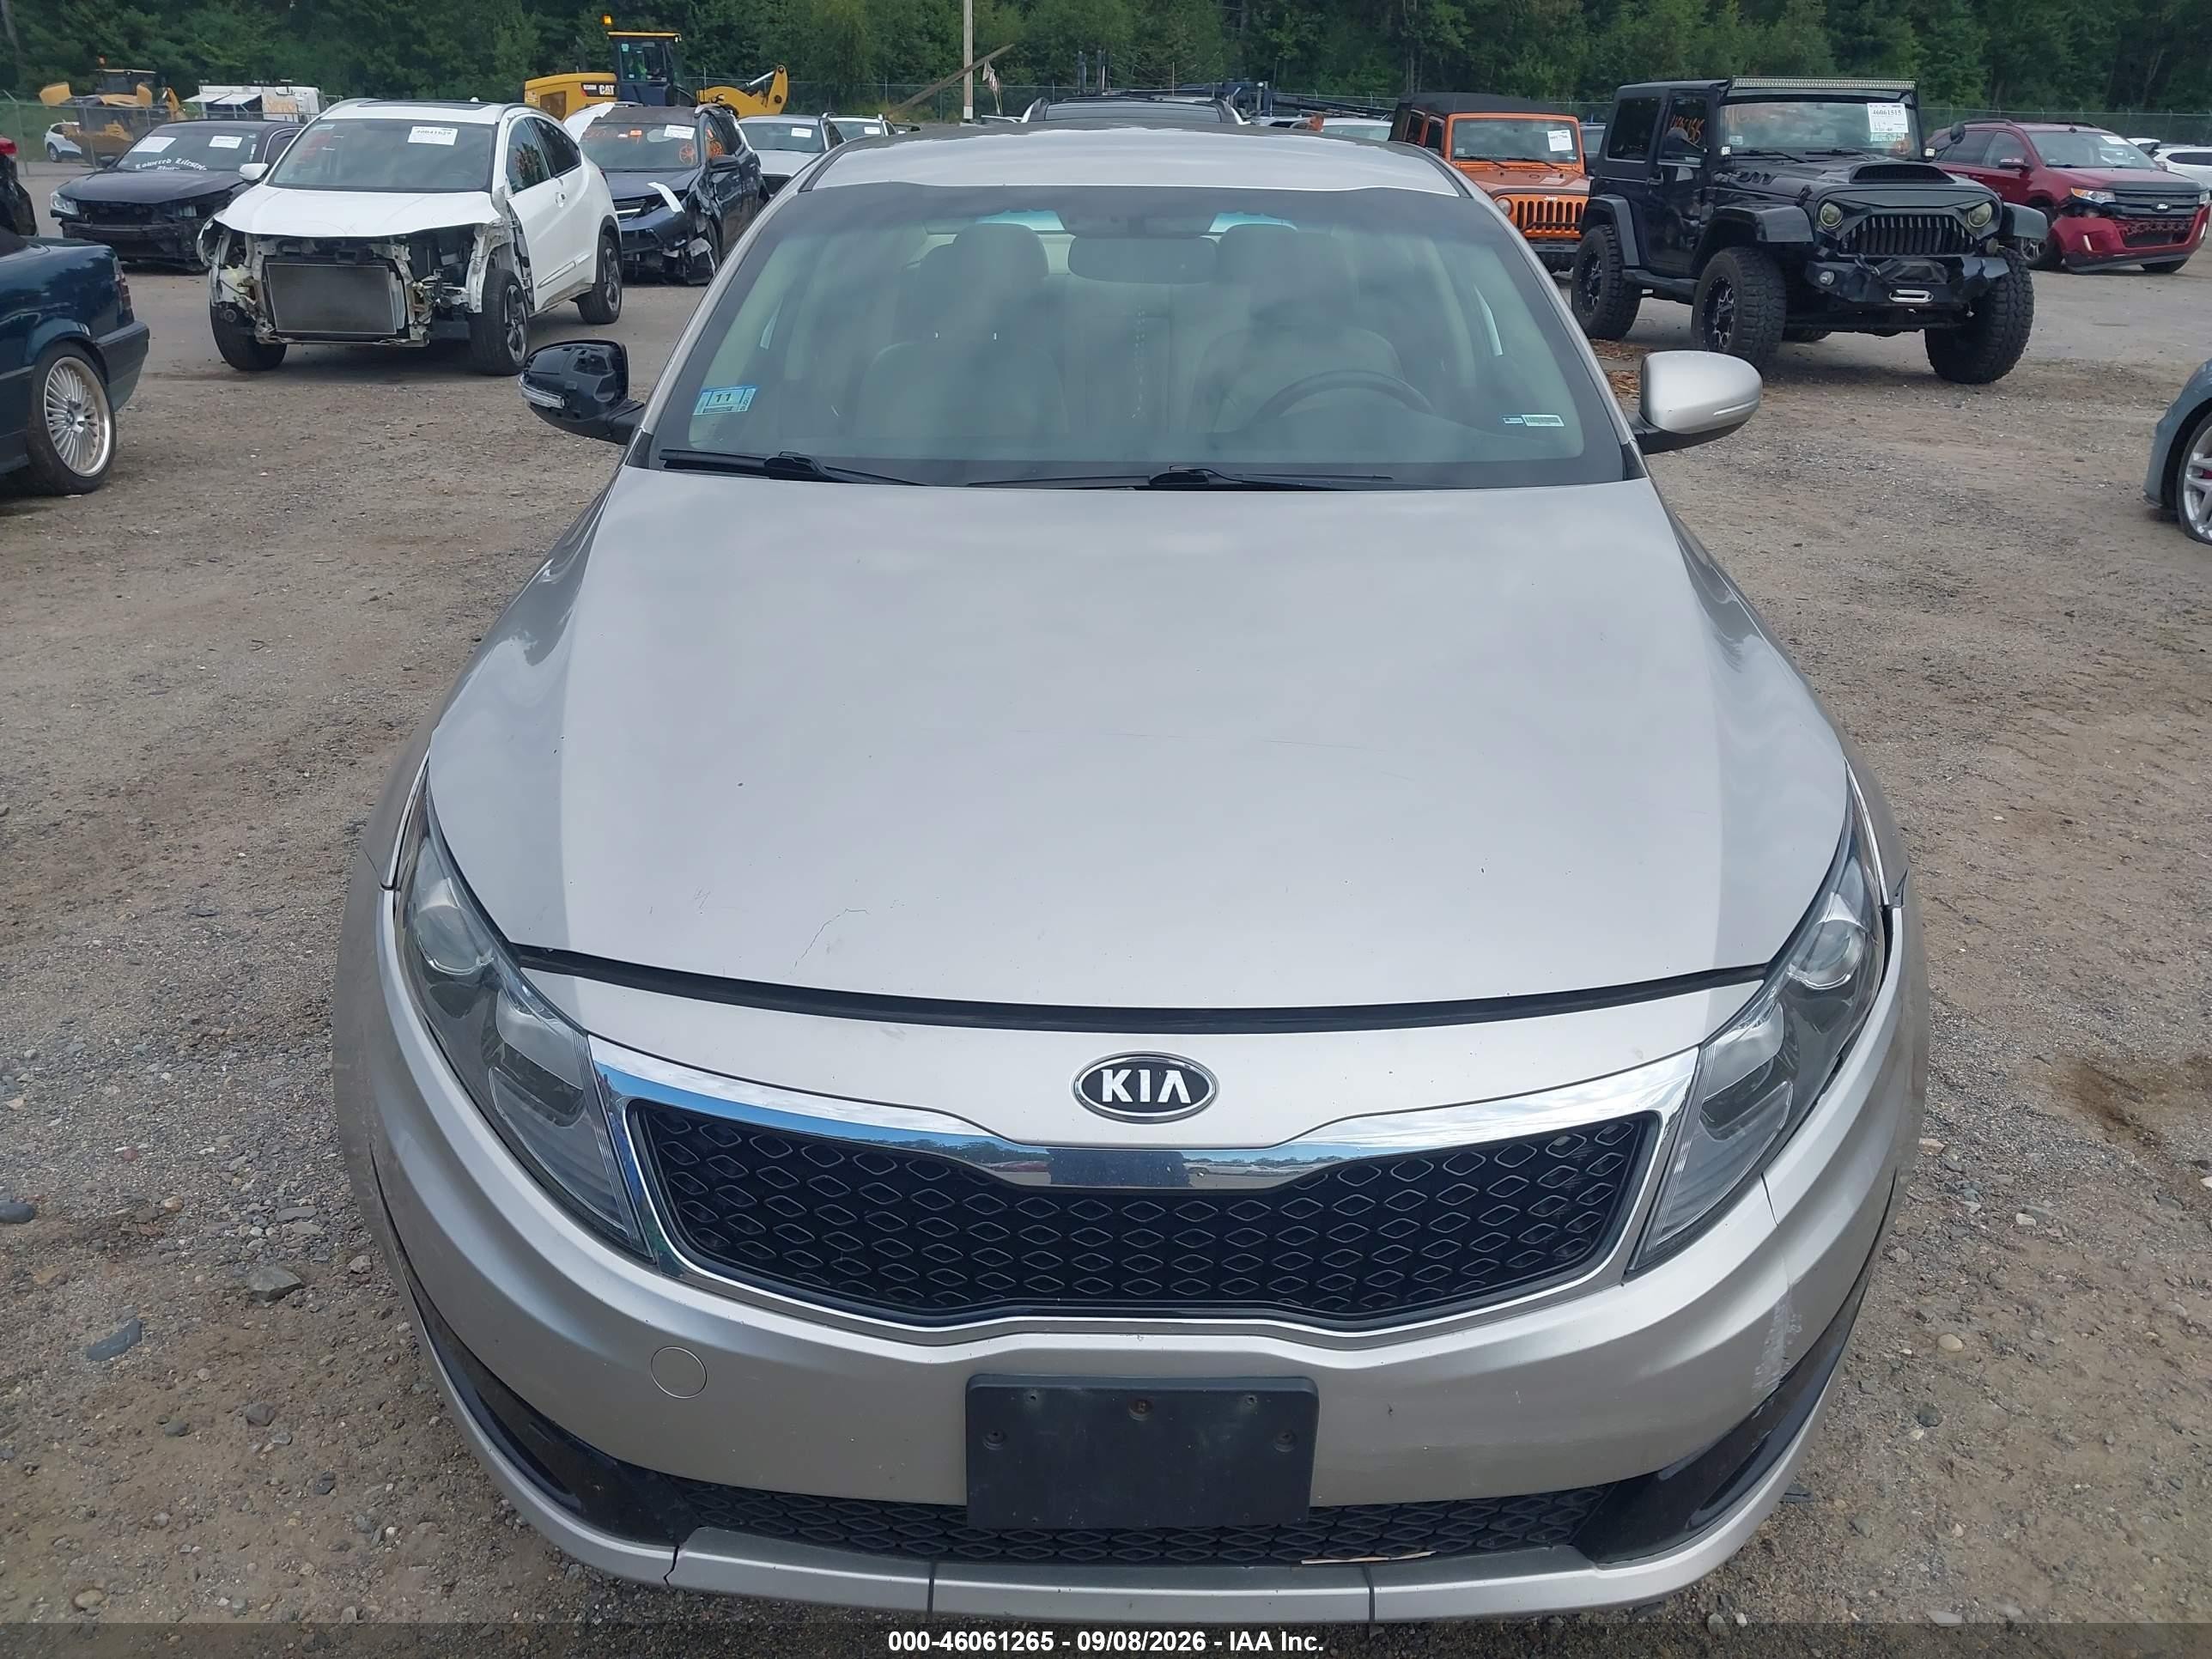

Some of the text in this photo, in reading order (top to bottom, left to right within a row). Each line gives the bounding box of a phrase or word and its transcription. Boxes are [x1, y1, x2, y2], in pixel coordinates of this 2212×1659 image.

[599, 84, 615, 95] CAT
[715, 393, 732, 403] 11
[1101, 1069, 1192, 1103] KIA
